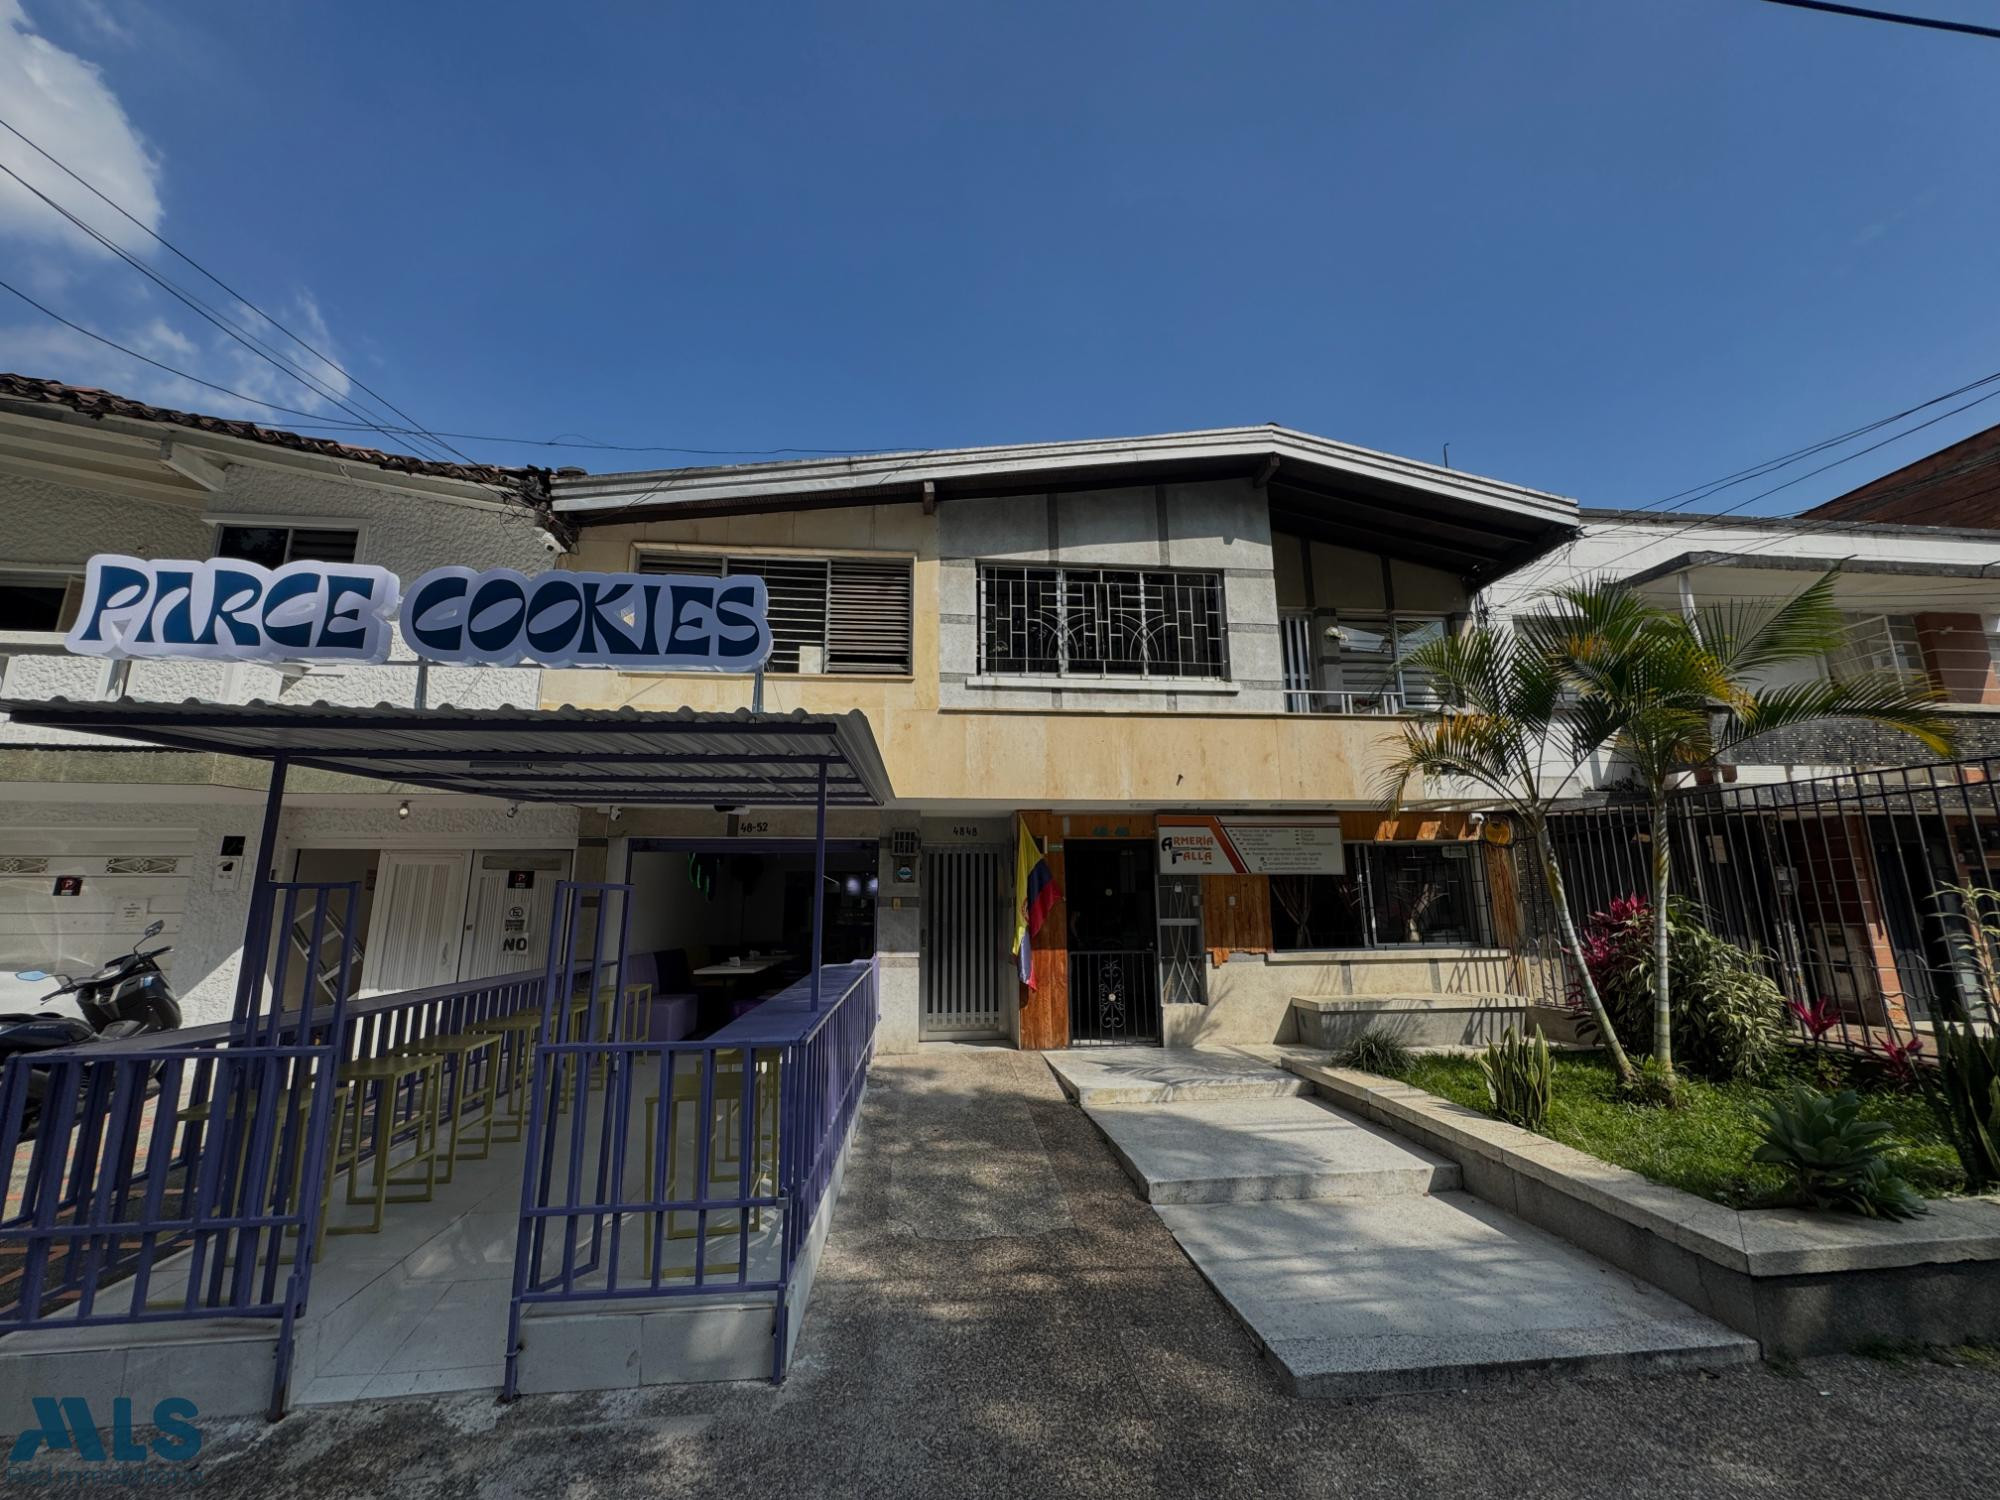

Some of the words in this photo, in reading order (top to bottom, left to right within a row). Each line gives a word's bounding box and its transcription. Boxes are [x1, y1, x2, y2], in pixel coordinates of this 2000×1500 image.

[86, 564, 374, 649] PARCE
[411, 576, 761, 657] COOKIES
[740, 822, 769, 833] 48-52
[953, 826, 978, 837] 4848
[1171, 851, 1212, 865] FALLA
[503, 938, 527, 951] NO
